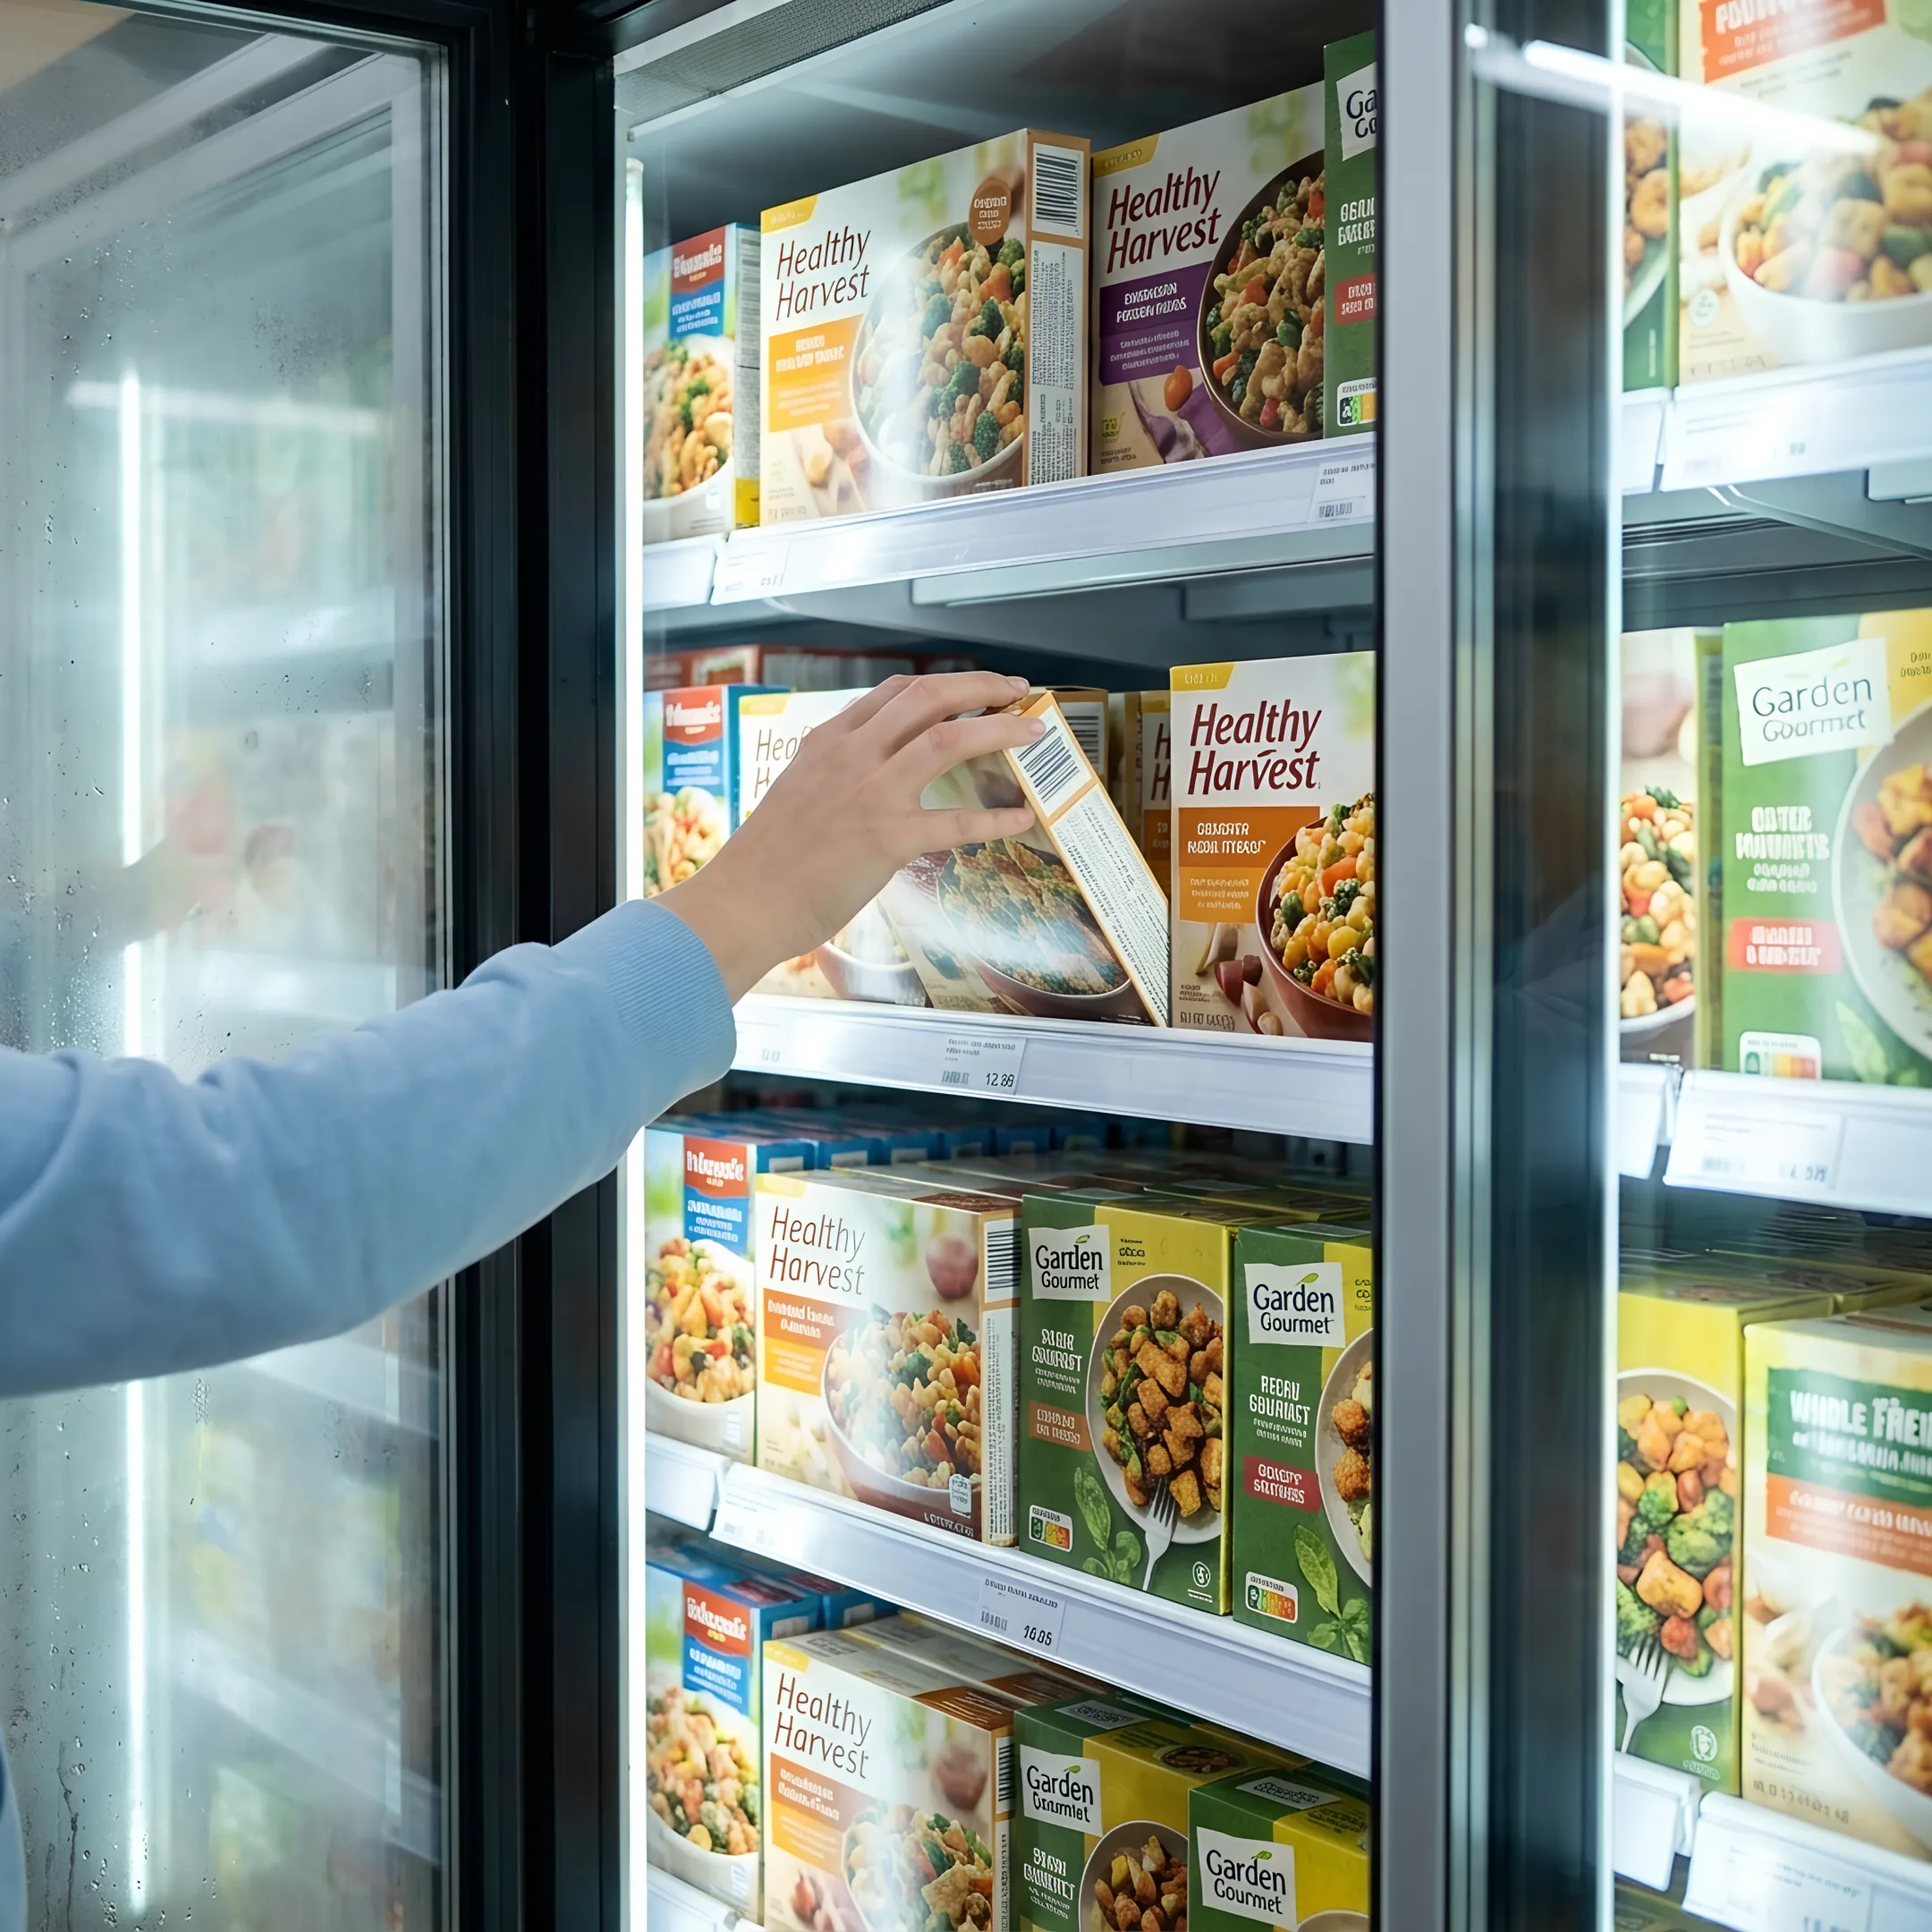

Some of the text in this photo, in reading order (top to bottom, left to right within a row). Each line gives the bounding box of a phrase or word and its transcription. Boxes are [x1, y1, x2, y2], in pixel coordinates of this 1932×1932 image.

[1107, 166, 1221, 230] Healthy
[776, 225, 871, 280] Healthy
[1106, 208, 1222, 274] Harvest
[776, 264, 870, 321] Harvest
[1752, 675, 1872, 716] Garden
[1190, 699, 1322, 753] Healthy
[1188, 750, 1321, 795] Harvest
[771, 1206, 866, 1263] Healthy
[1036, 1244, 1103, 1270] Garden
[769, 1244, 865, 1295] Harvest
[1041, 1270, 1100, 1290] Gourmet
[1253, 1284, 1335, 1313] Garden
[1260, 1312, 1335, 1334] Gourmet
[776, 1673, 872, 1747] Healthy
[775, 1711, 869, 1779] Harvest
[1026, 1765, 1094, 1805] Garden
[1207, 1850, 1286, 1895] Garden
[1214, 1878, 1283, 1914] Gourmet
